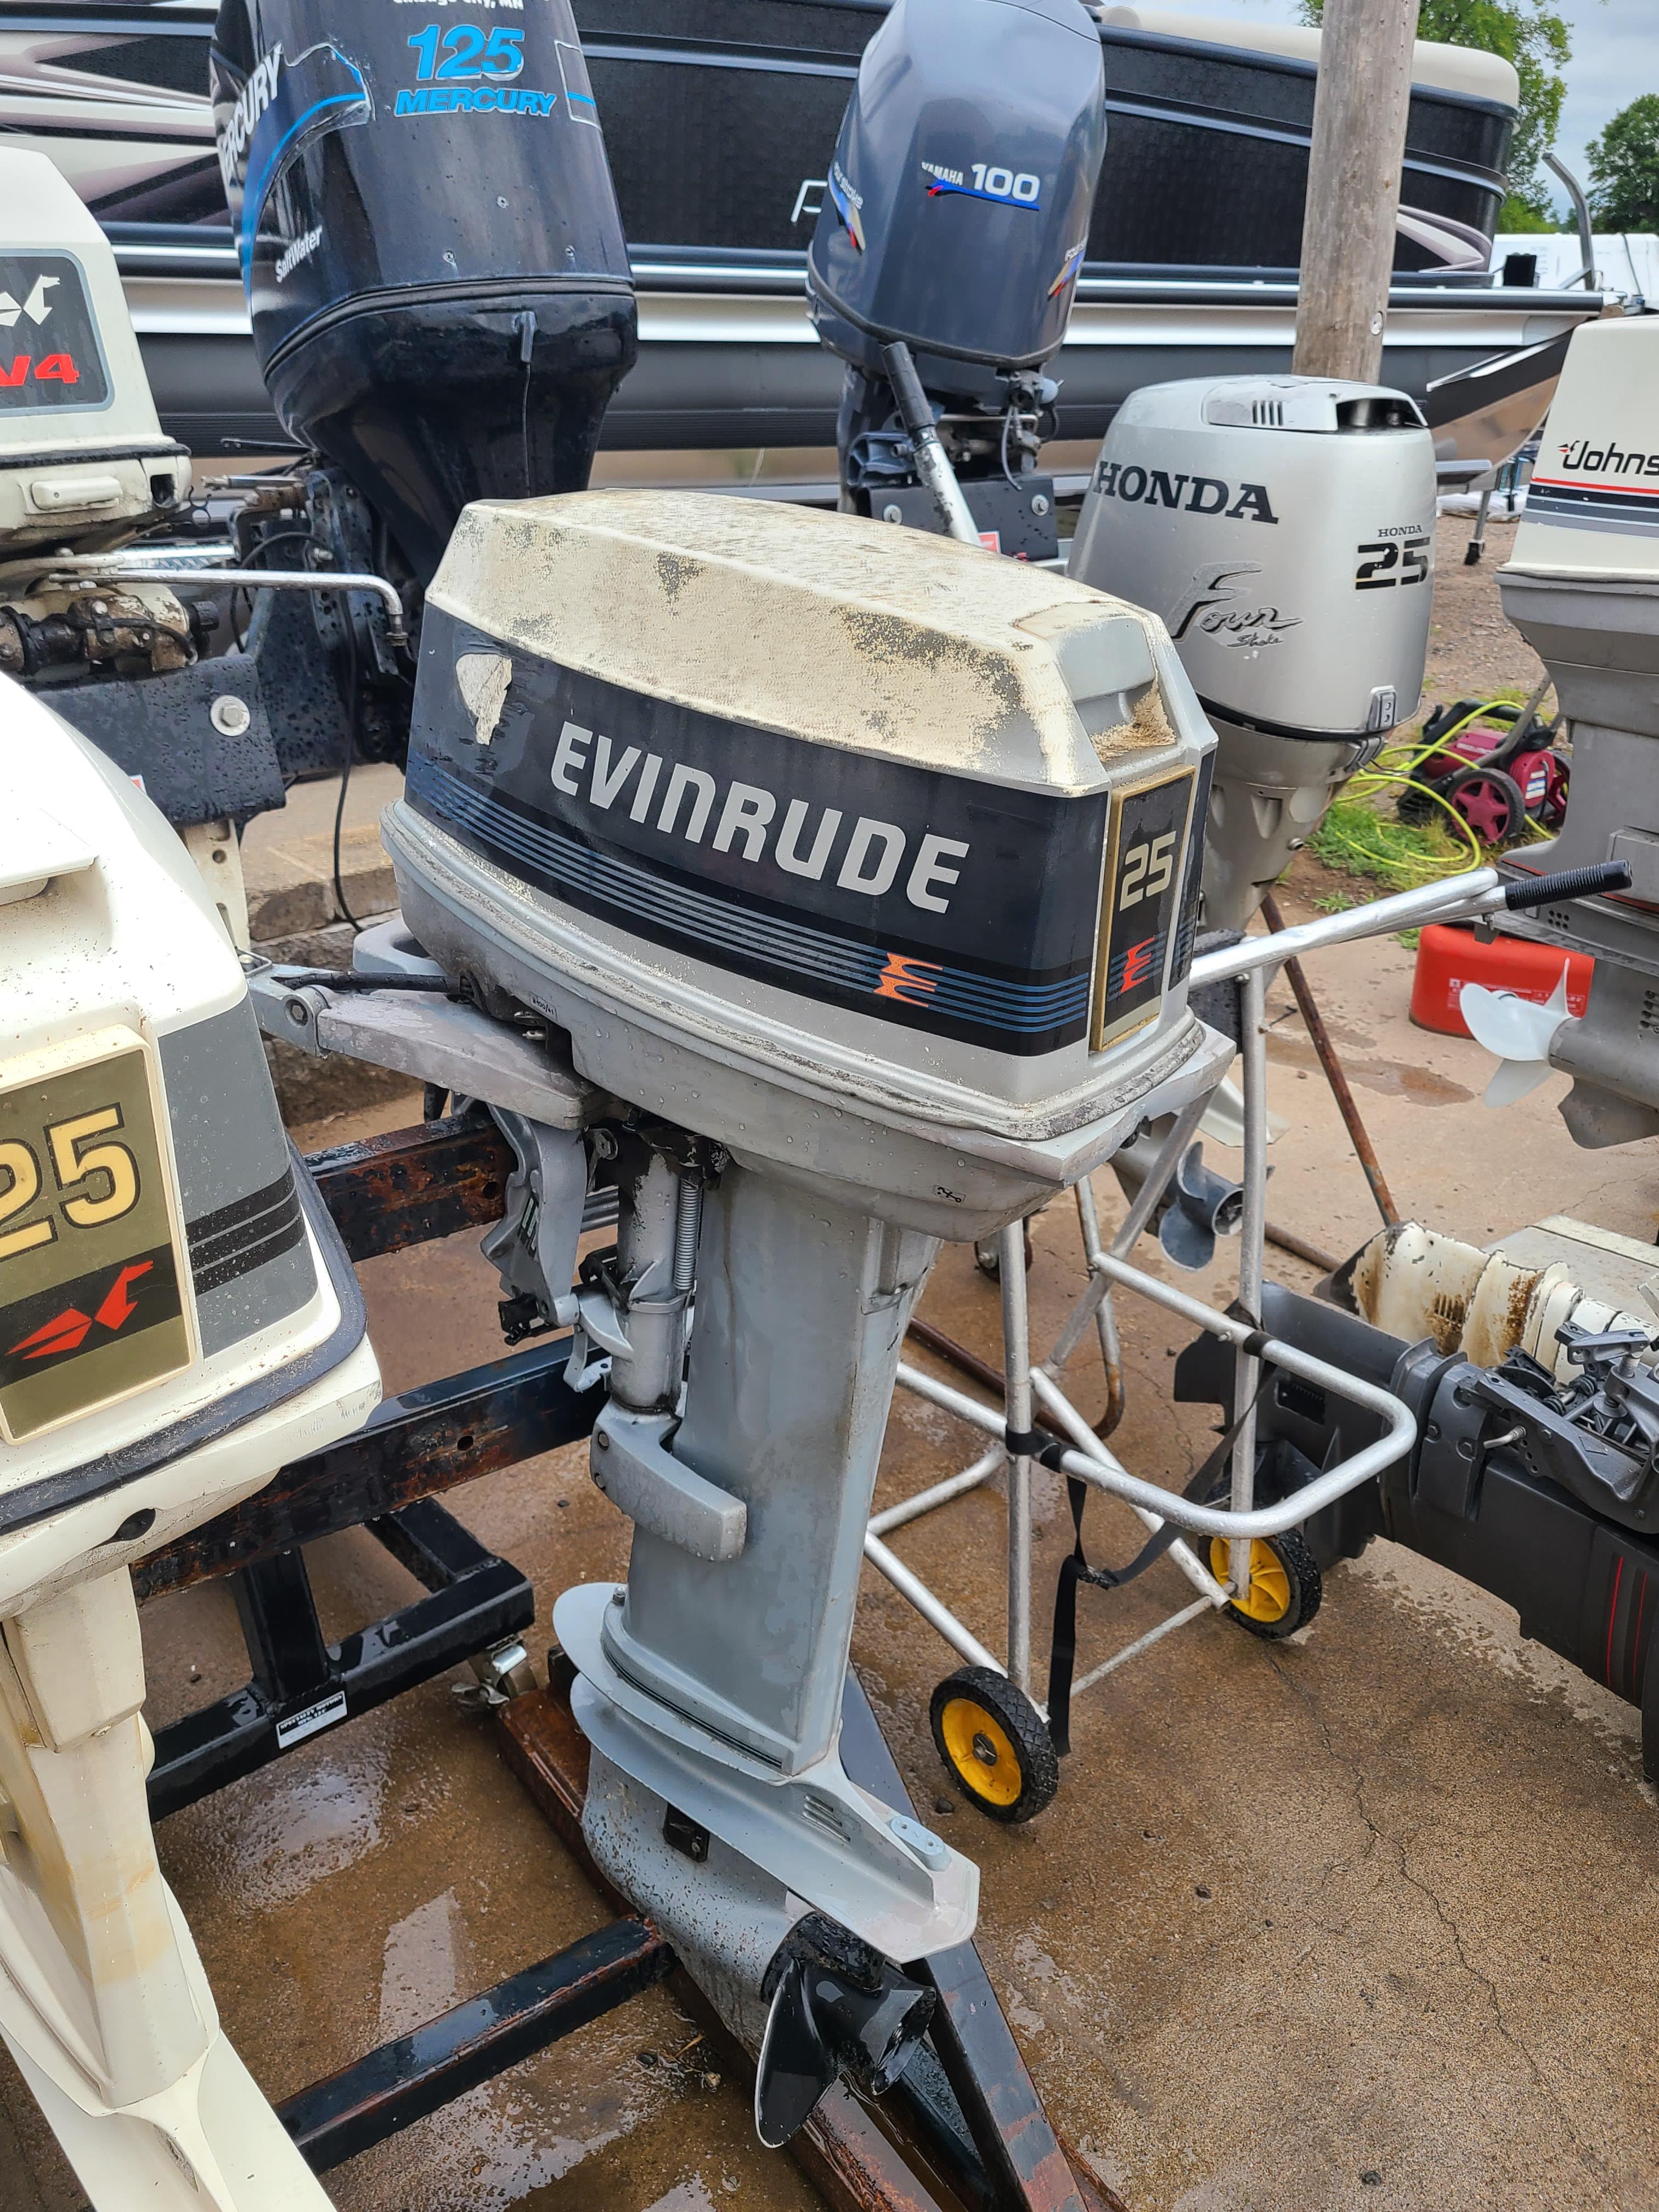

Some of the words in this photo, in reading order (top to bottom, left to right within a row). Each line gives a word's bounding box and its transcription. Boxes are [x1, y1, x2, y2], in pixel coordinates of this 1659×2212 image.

[408, 24, 525, 81] 125
[394, 87, 558, 117] MERCURY
[921, 161, 964, 187] YAMAHA
[971, 163, 1041, 202] 100
[275, 224, 323, 283] SaltWater
[1092, 460, 1279, 525] HONDA
[1378, 524, 1423, 538] HONDA
[1355, 536, 1431, 590] 25
[550, 721, 970, 915] EVINRUDE
[1119, 830, 1176, 912] 25
